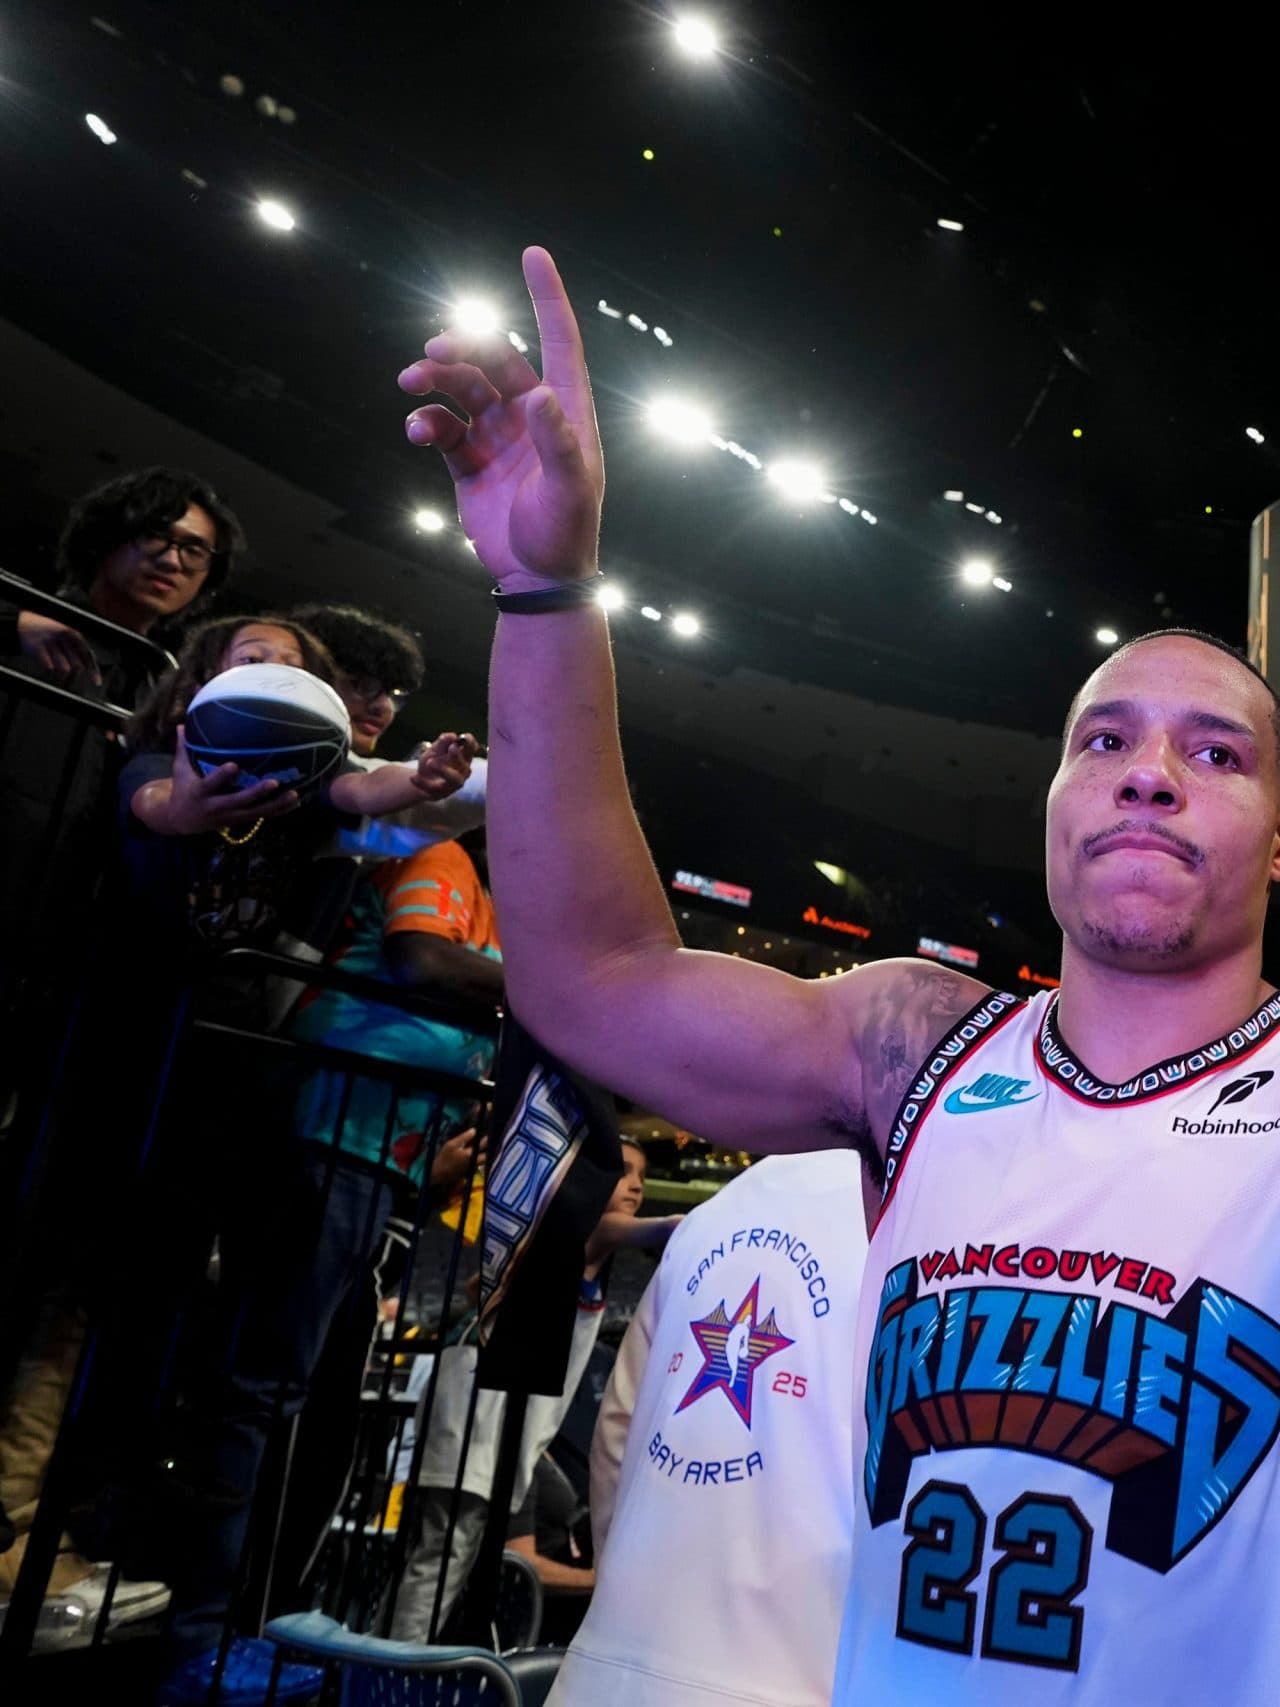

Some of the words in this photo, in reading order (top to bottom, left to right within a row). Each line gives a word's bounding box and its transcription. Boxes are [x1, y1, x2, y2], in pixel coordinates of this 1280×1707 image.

[963, 1072, 1032, 1101] NIKE
[686, 1241, 725, 1296] SAN
[730, 1228, 830, 1318] FRANCISCO
[919, 1242, 1177, 1305] VANCOUVER
[771, 1371, 808, 1399] 25
[648, 1431, 684, 1478] BAY
[682, 1451, 764, 1485] AREA
[896, 1478, 1094, 1674] 22
